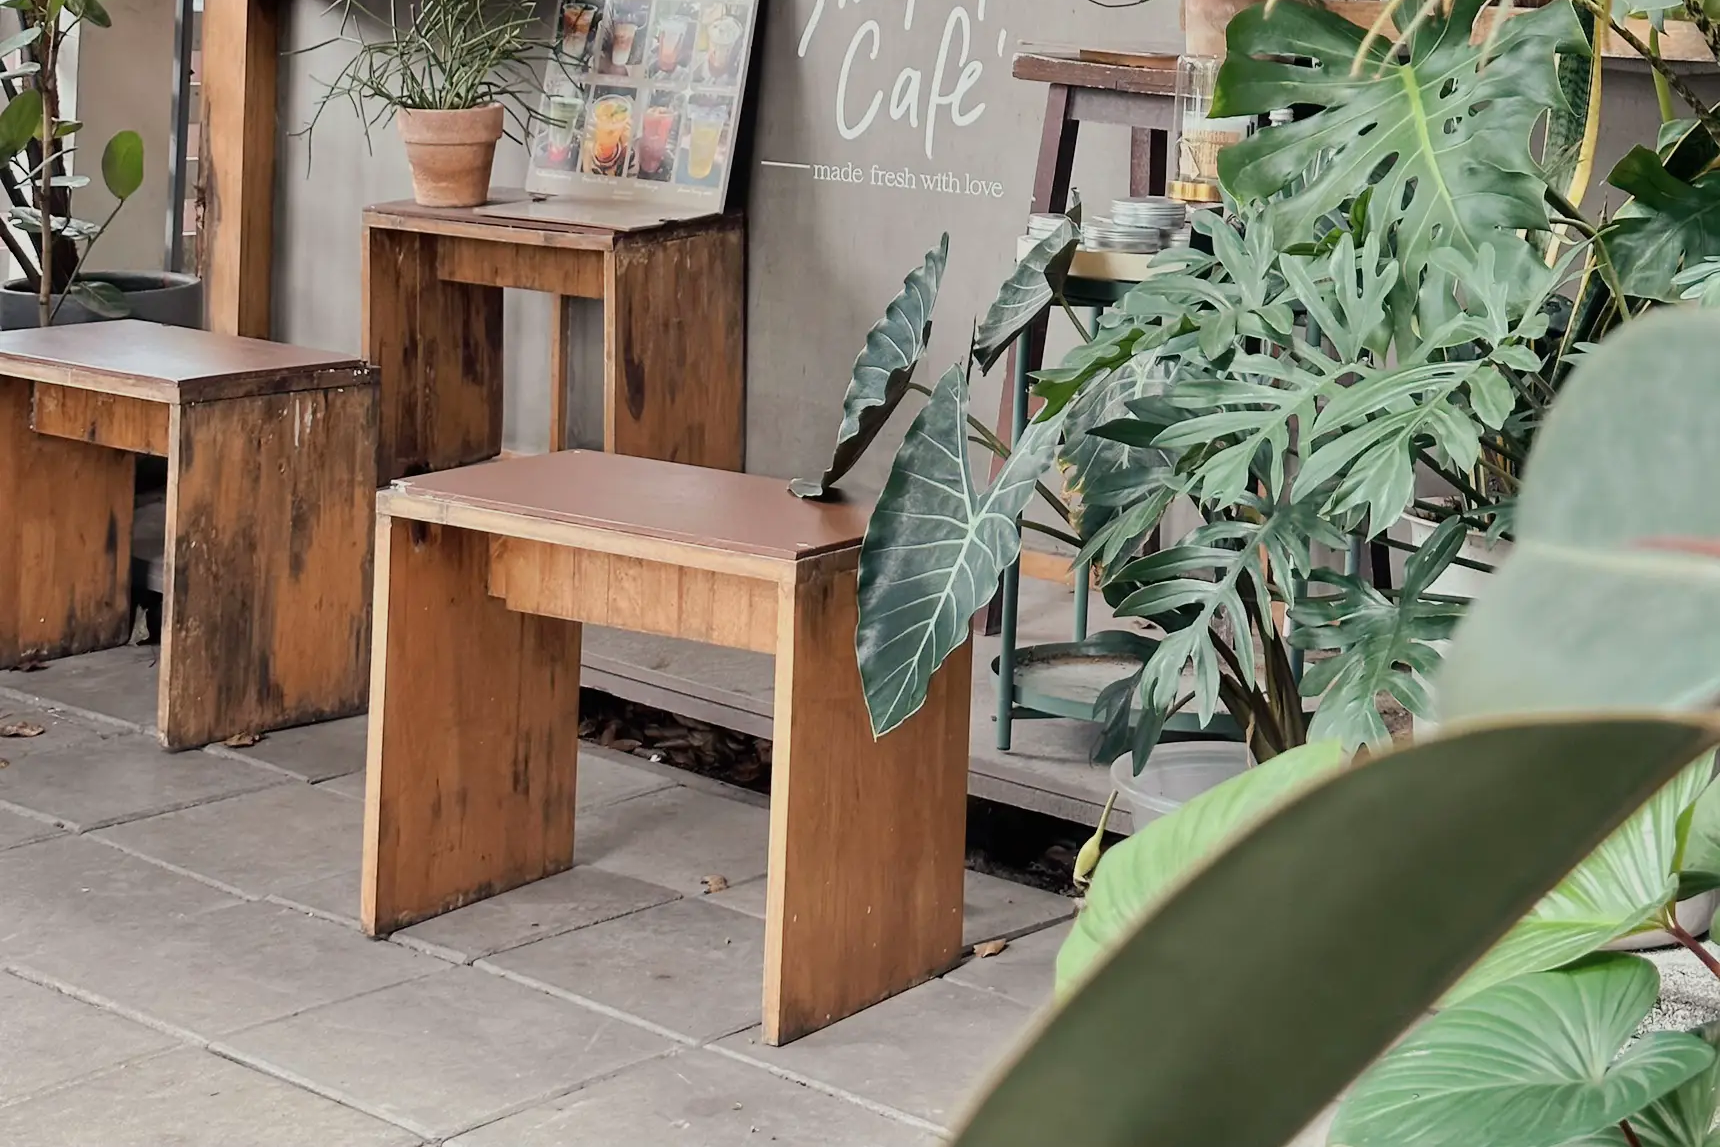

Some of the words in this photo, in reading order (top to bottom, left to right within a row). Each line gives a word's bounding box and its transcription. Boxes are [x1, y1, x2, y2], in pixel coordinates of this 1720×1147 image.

[813, 162, 864, 183] made
[870, 165, 916, 189] fresh
[920, 172, 960, 194] with
[965, 174, 1004, 198] love
